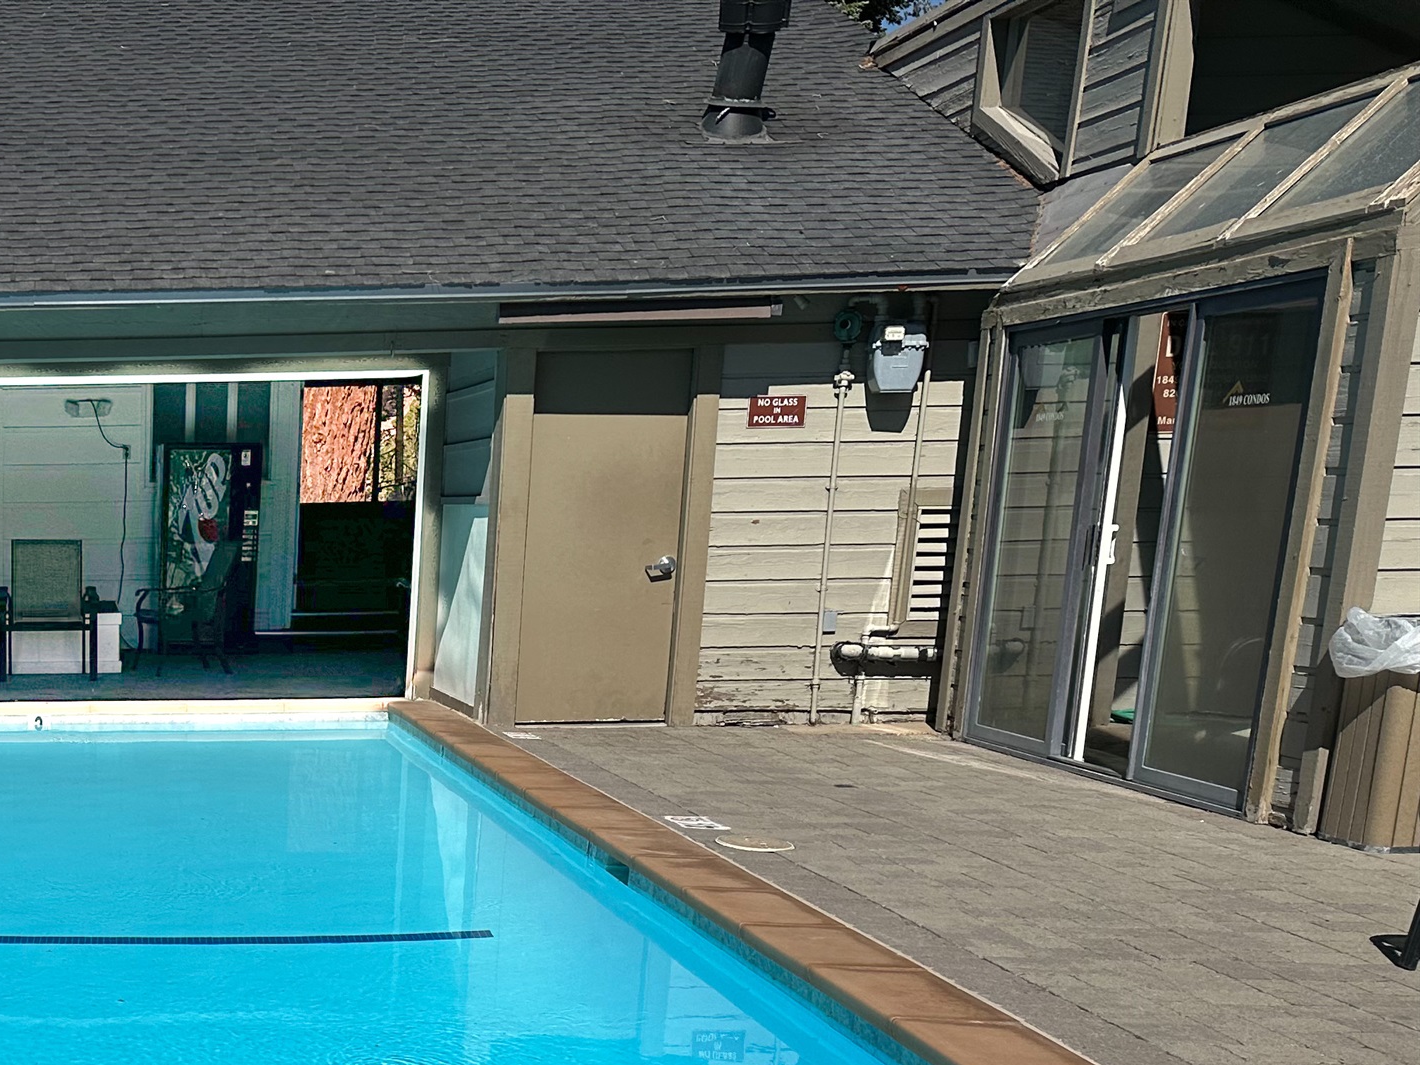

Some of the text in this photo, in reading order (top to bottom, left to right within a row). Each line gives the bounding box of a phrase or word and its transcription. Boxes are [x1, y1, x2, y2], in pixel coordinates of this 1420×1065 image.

[757, 398, 798, 407] NO GLASS
[1243, 393, 1270, 405] CONDOS
[753, 415, 799, 424] POOL AREA
